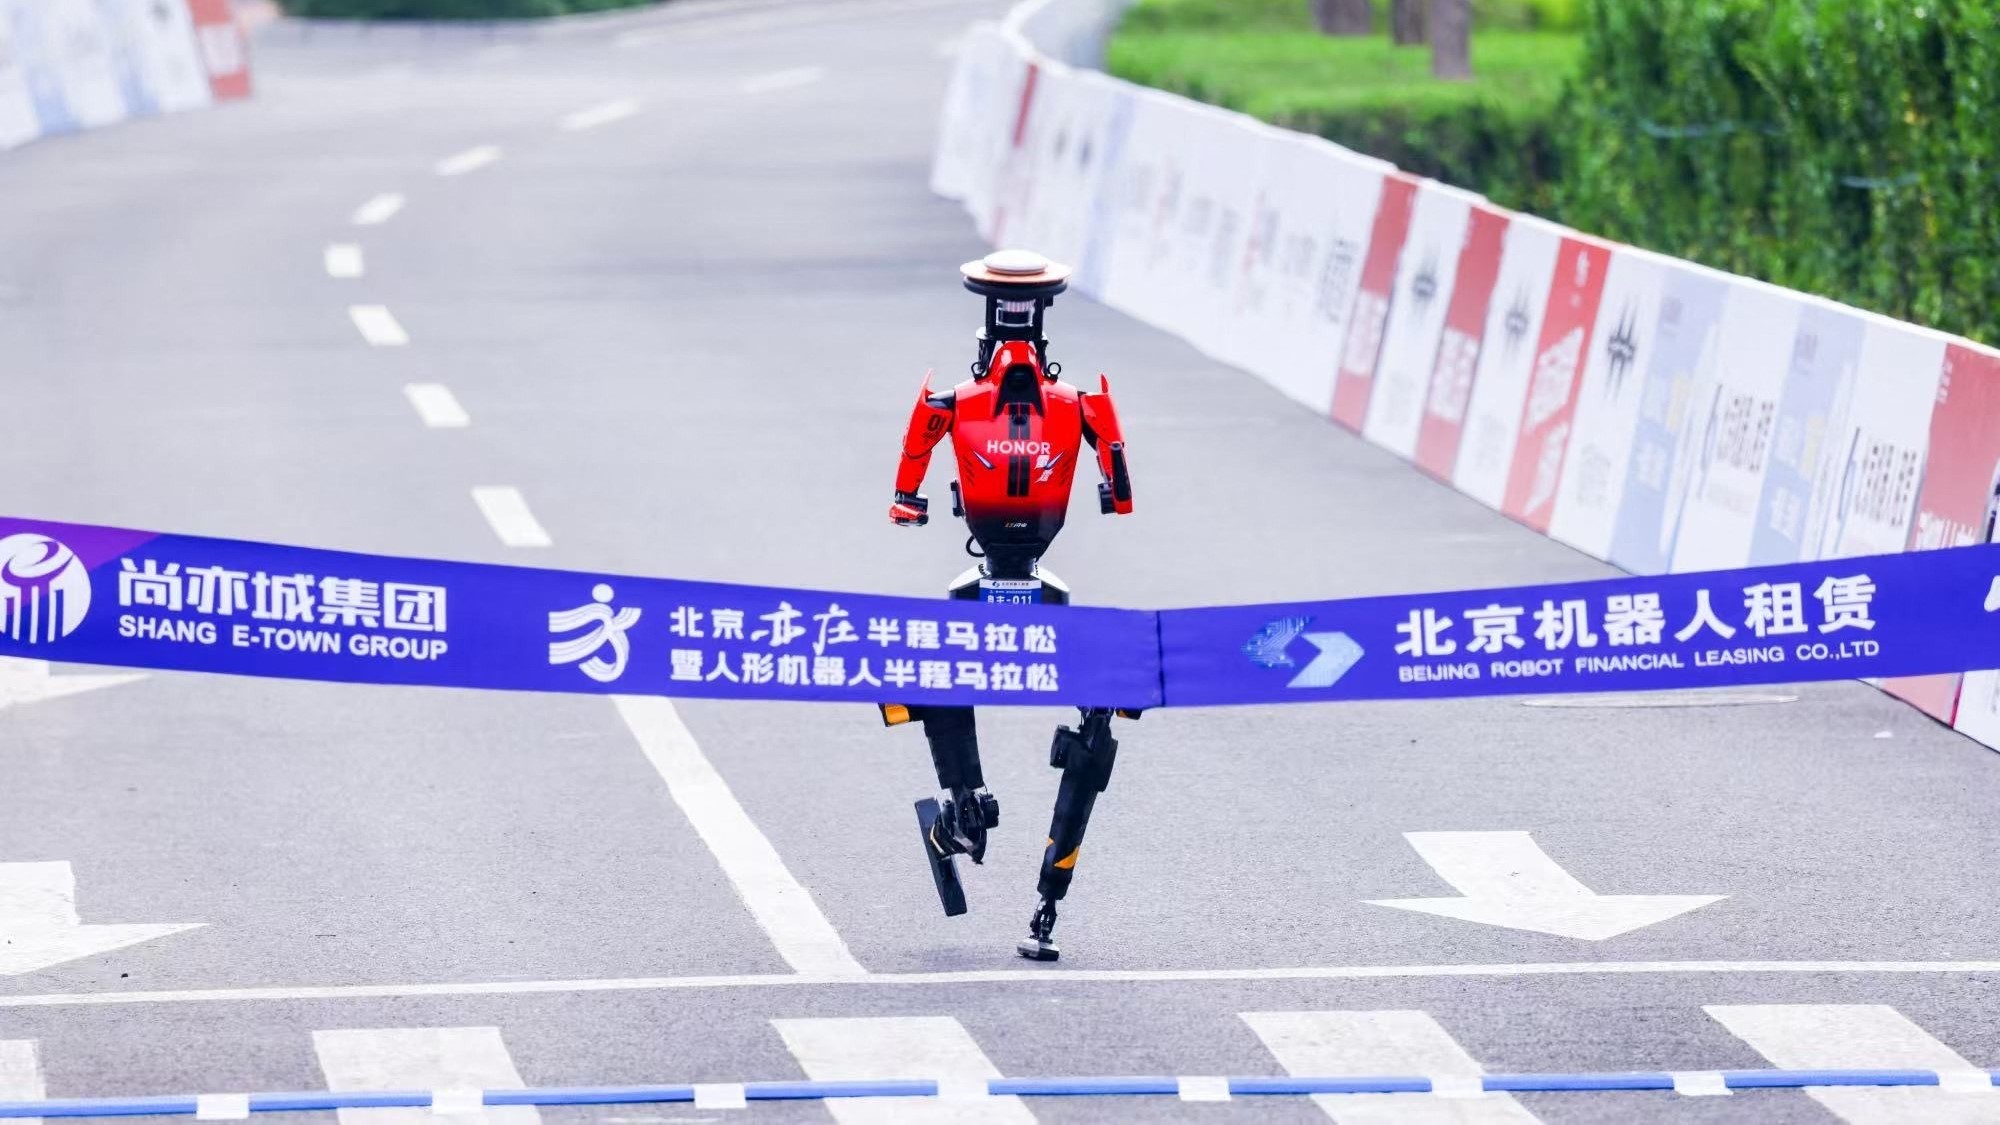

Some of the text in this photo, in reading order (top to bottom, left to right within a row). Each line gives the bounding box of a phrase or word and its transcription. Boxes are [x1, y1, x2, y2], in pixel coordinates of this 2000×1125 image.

[986, 440, 1051, 455] HONOR
[118, 557, 448, 633] 尚亦城集团
[1394, 573, 1877, 658] 北京机器人租赁
[118, 614, 448, 661] SHANG E-TOWN GROUP
[670, 648, 1059, 692] 暨人形机器人半程马拉松
[1398, 640, 1880, 683] BEIJING ROBOT FINANCIAL LEASING CO.,LTD
